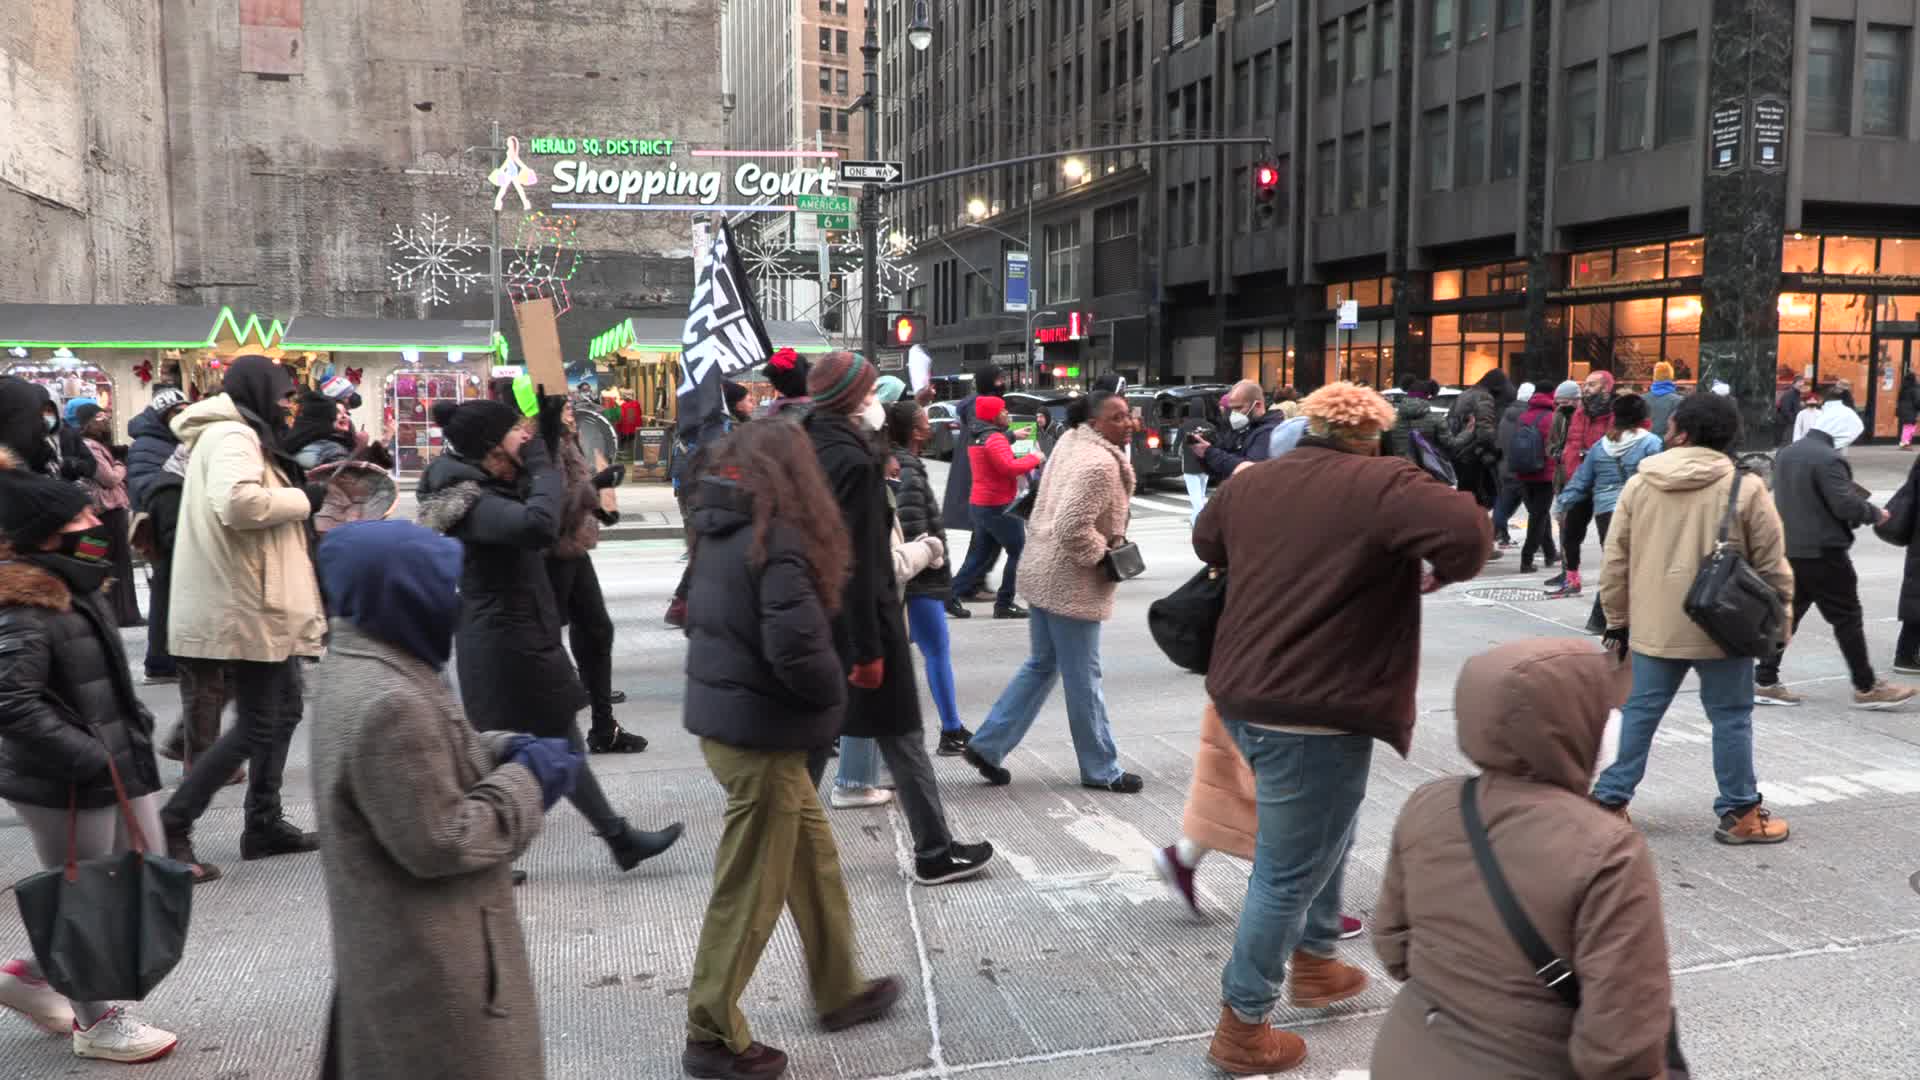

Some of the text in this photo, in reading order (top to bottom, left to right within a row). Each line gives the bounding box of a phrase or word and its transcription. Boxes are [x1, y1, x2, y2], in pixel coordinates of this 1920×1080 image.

[531, 139, 576, 153] HERALD
[606, 139, 673, 155] DISTRICT
[849, 168, 894, 177] ONE WAY
[551, 160, 836, 205] Shopping Court
[800, 200, 847, 211] AMERICAS
[824, 216, 832, 228] 6
